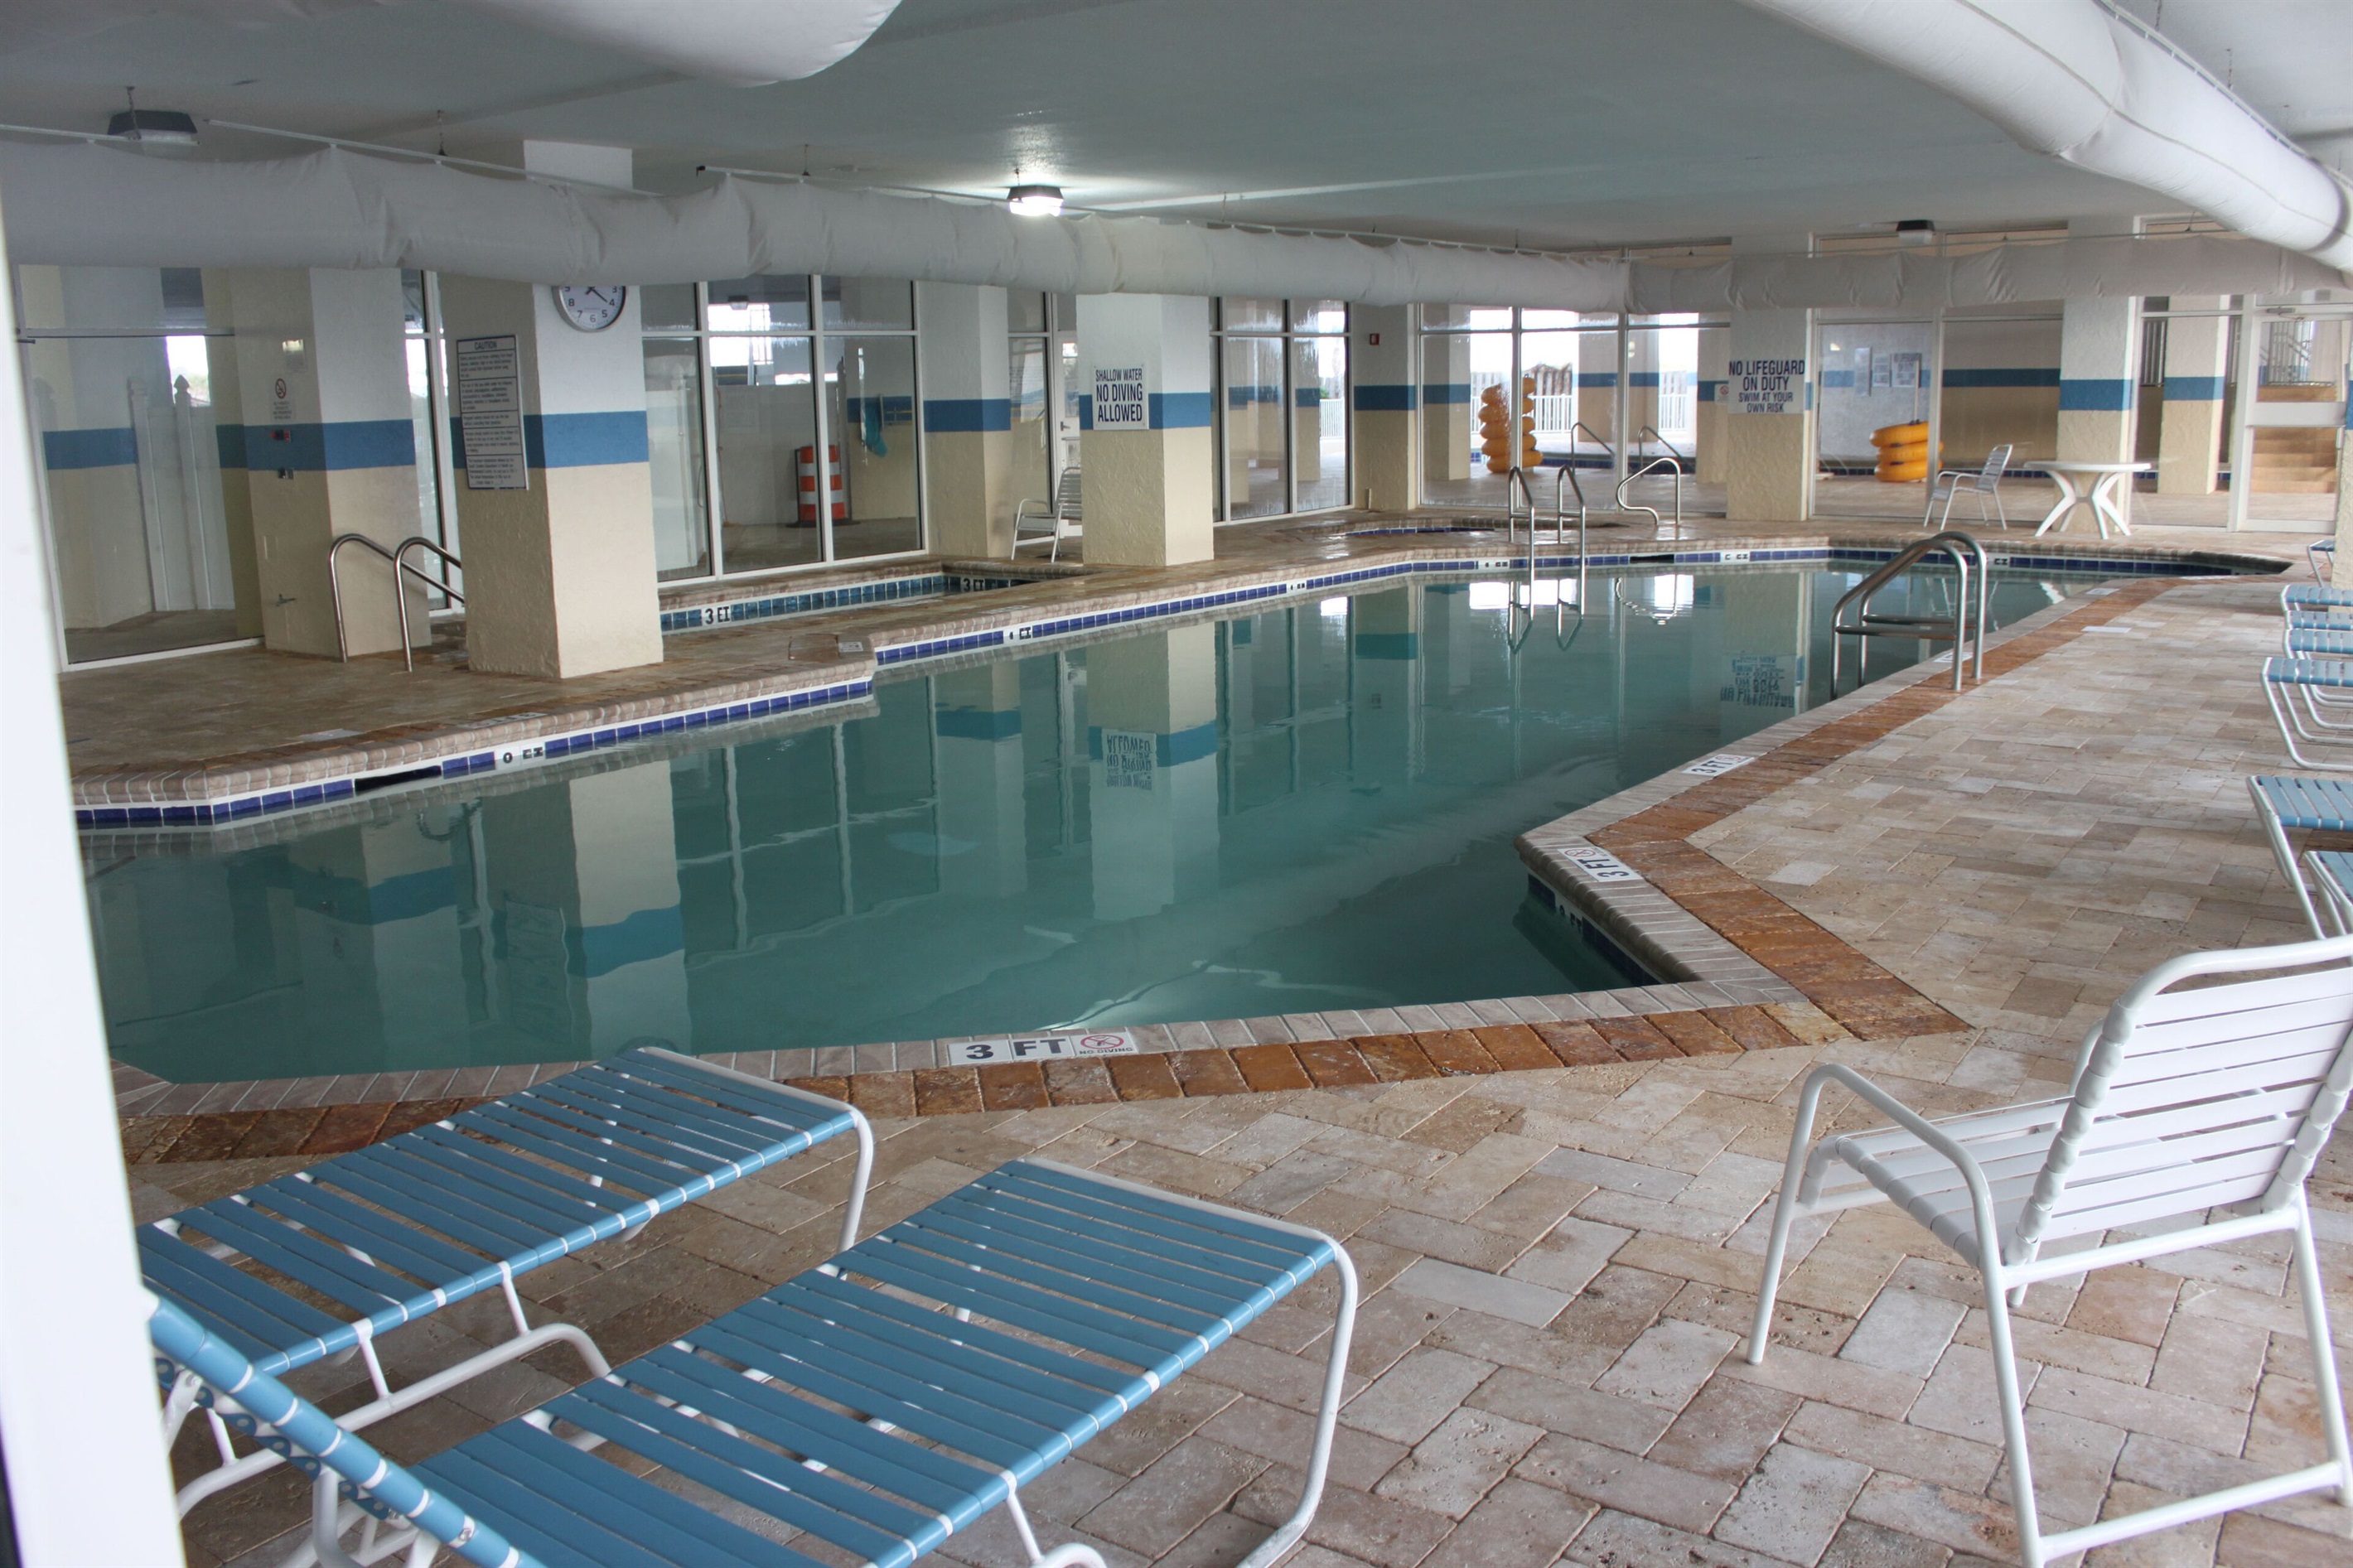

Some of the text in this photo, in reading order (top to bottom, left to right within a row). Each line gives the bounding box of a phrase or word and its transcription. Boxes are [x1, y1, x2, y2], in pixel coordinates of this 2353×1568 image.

[568, 298, 575, 306] 8
[577, 310, 582, 318] 7
[589, 314, 597, 323] 6
[602, 310, 608, 318] 5
[474, 340, 497, 350] CAUTION
[1728, 359, 1805, 375] NO LIFEGUARD
[1095, 368, 1143, 382] SHALLOW WATER
[1743, 376, 1789, 391] ON DUTY
[1096, 383, 1143, 402] NO DIVING
[1738, 392, 1760, 403] SWIM
[1761, 392, 1771, 402] AT
[1773, 392, 1793, 402] YOUR
[1098, 403, 1143, 422] ALLOWED
[1747, 403, 1785, 413] OWN RISK
[1700, 760, 1732, 769] FT
[1577, 859, 1619, 869] FT
[966, 1038, 1065, 1059] 3 FT
